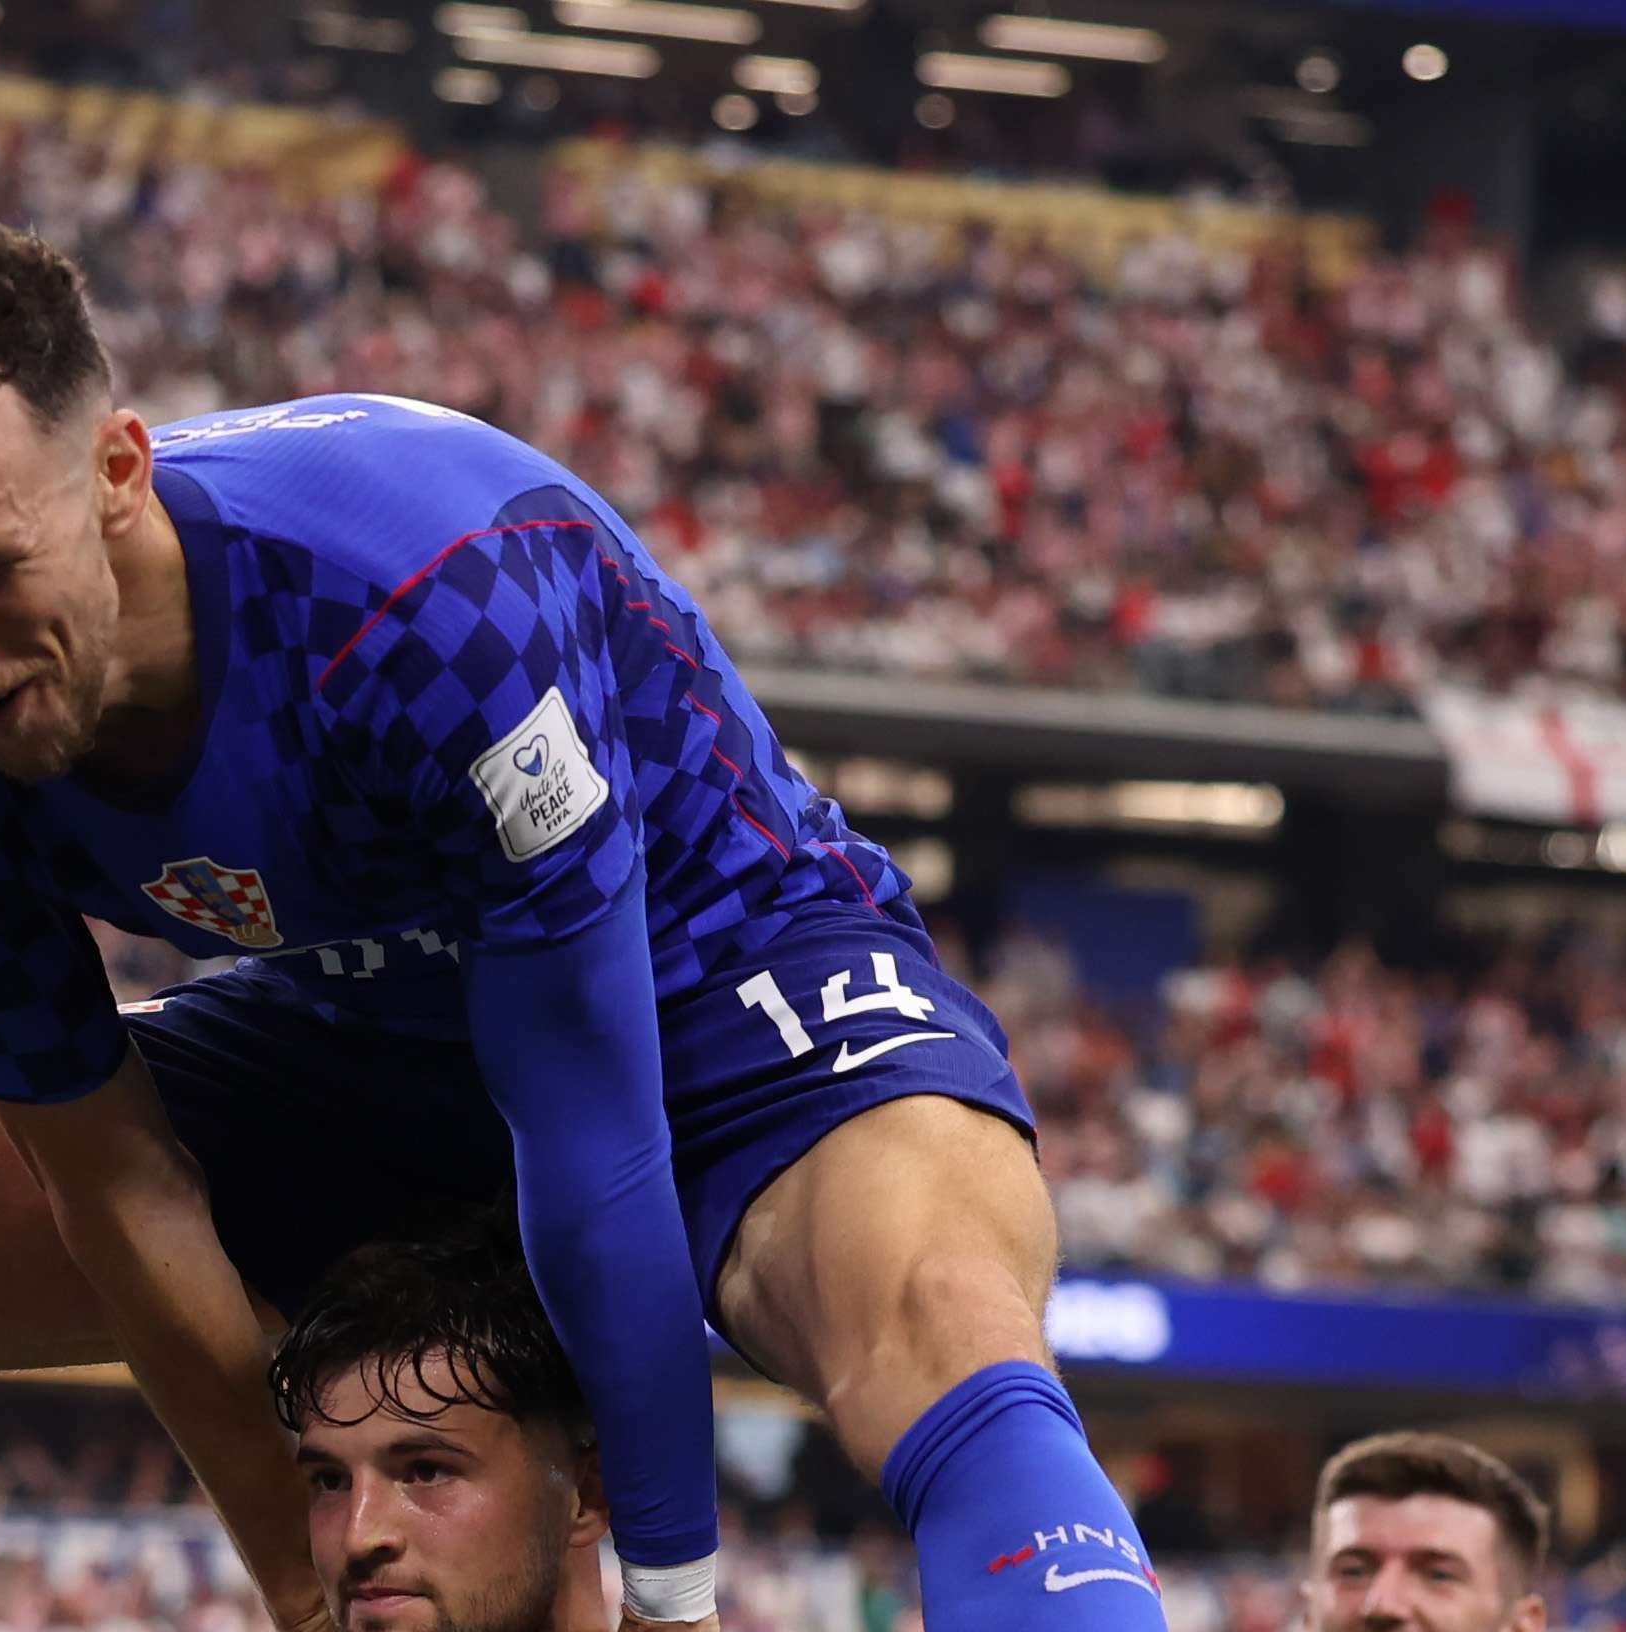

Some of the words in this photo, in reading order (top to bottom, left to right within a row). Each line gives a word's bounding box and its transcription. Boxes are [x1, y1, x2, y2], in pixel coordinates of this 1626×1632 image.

[529, 777, 575, 828] PEACE
[546, 809, 572, 832] FIFA
[736, 952, 935, 1057] 14
[1033, 1523, 1141, 1565] HNS
